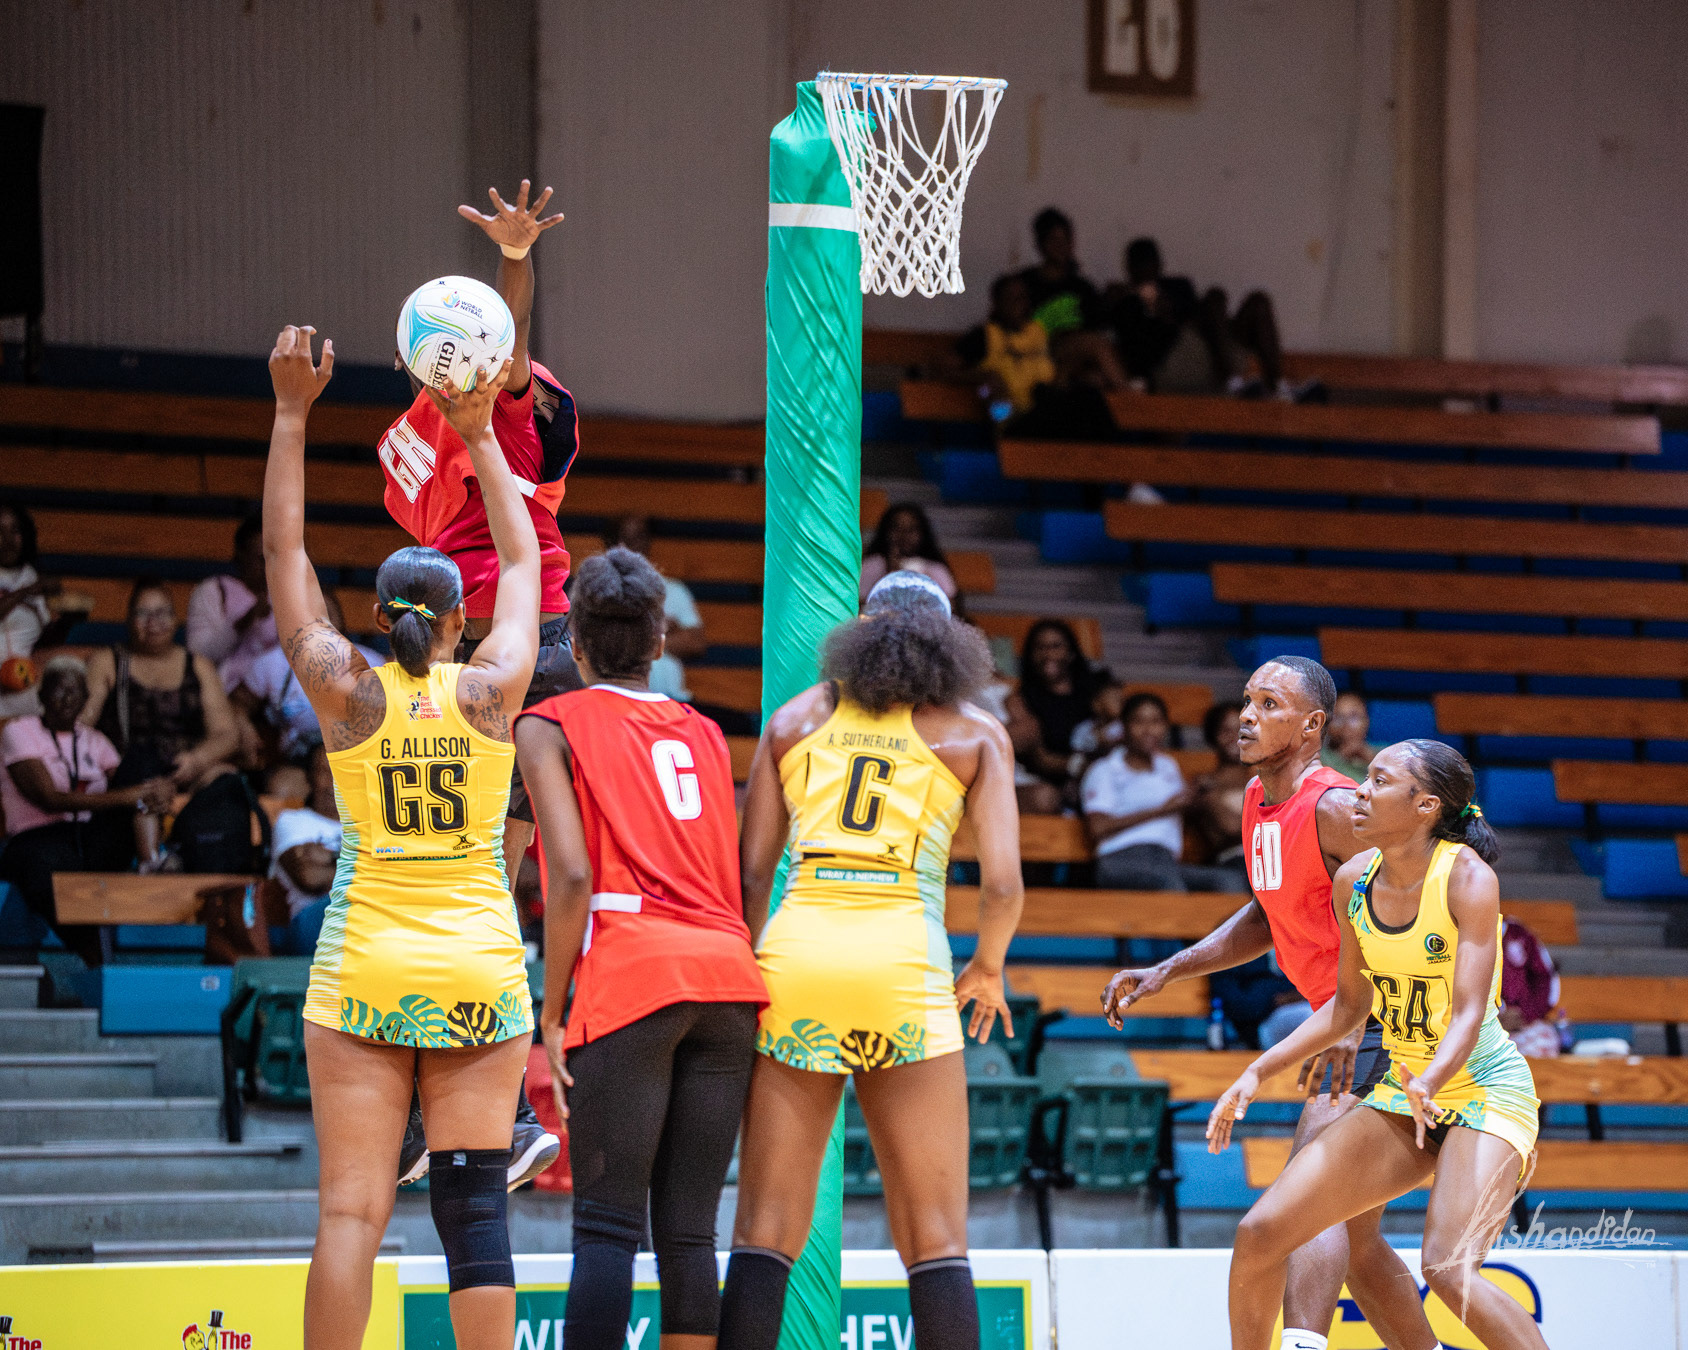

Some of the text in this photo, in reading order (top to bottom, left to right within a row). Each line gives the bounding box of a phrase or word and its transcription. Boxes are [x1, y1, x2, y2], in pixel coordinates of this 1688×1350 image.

[460, 304, 483, 319] NETBALL
[461, 300, 483, 313] WORLD
[378, 415, 437, 504] GK
[381, 737, 471, 759] G. ALLISON
[827, 732, 909, 753] A. SUTHERLAND
[651, 739, 702, 821] C
[377, 760, 469, 836] GS
[838, 751, 896, 837] C
[375, 846, 405, 854] WATA
[1251, 821, 1283, 891] GD
[818, 870, 897, 883] WRAY & NEPHEW
[1371, 972, 1439, 1043] GA
[219, 1330, 252, 1350] The
